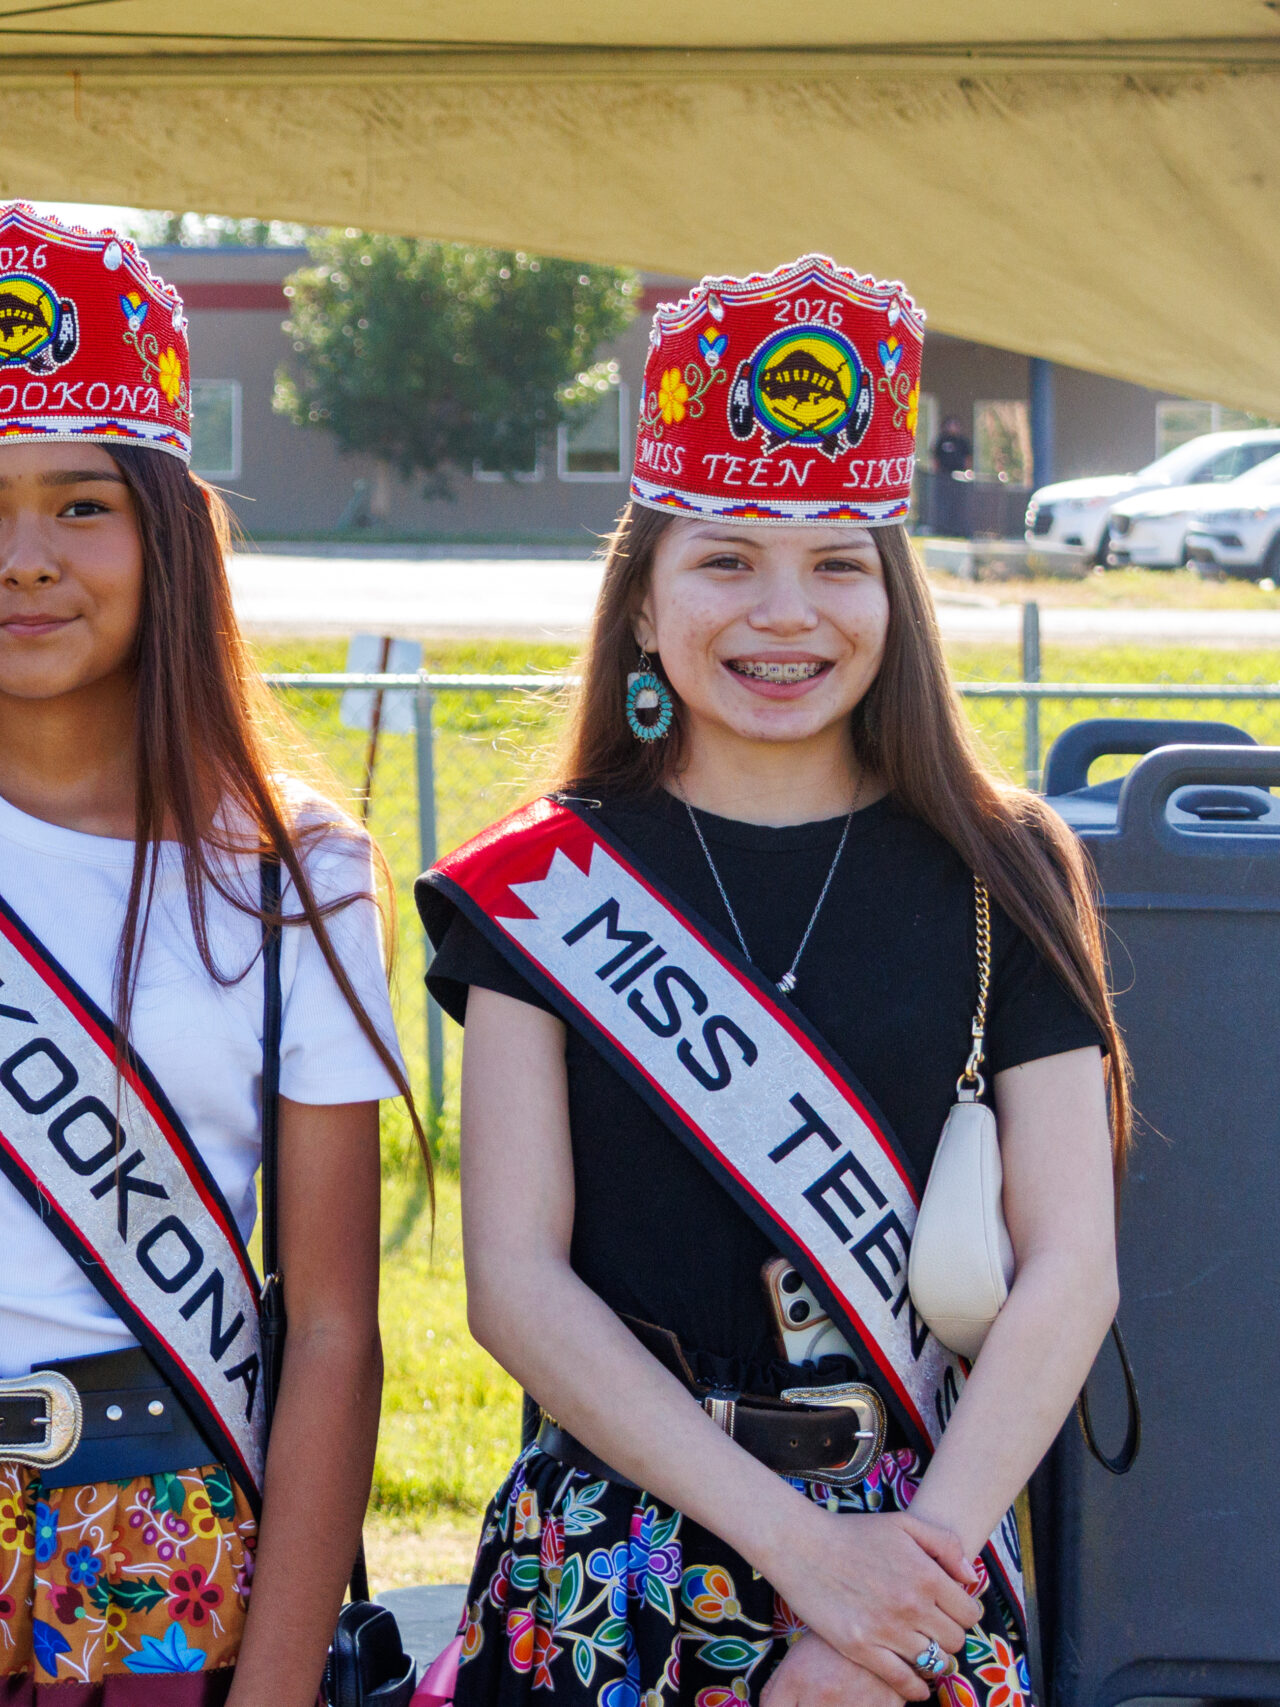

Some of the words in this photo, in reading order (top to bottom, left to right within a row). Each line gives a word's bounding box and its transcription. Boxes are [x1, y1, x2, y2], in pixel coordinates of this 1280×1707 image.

[773, 298, 844, 327] 2026
[639, 438, 686, 476] MISS
[702, 452, 816, 487] TEEN
[561, 896, 759, 1093] MISS
